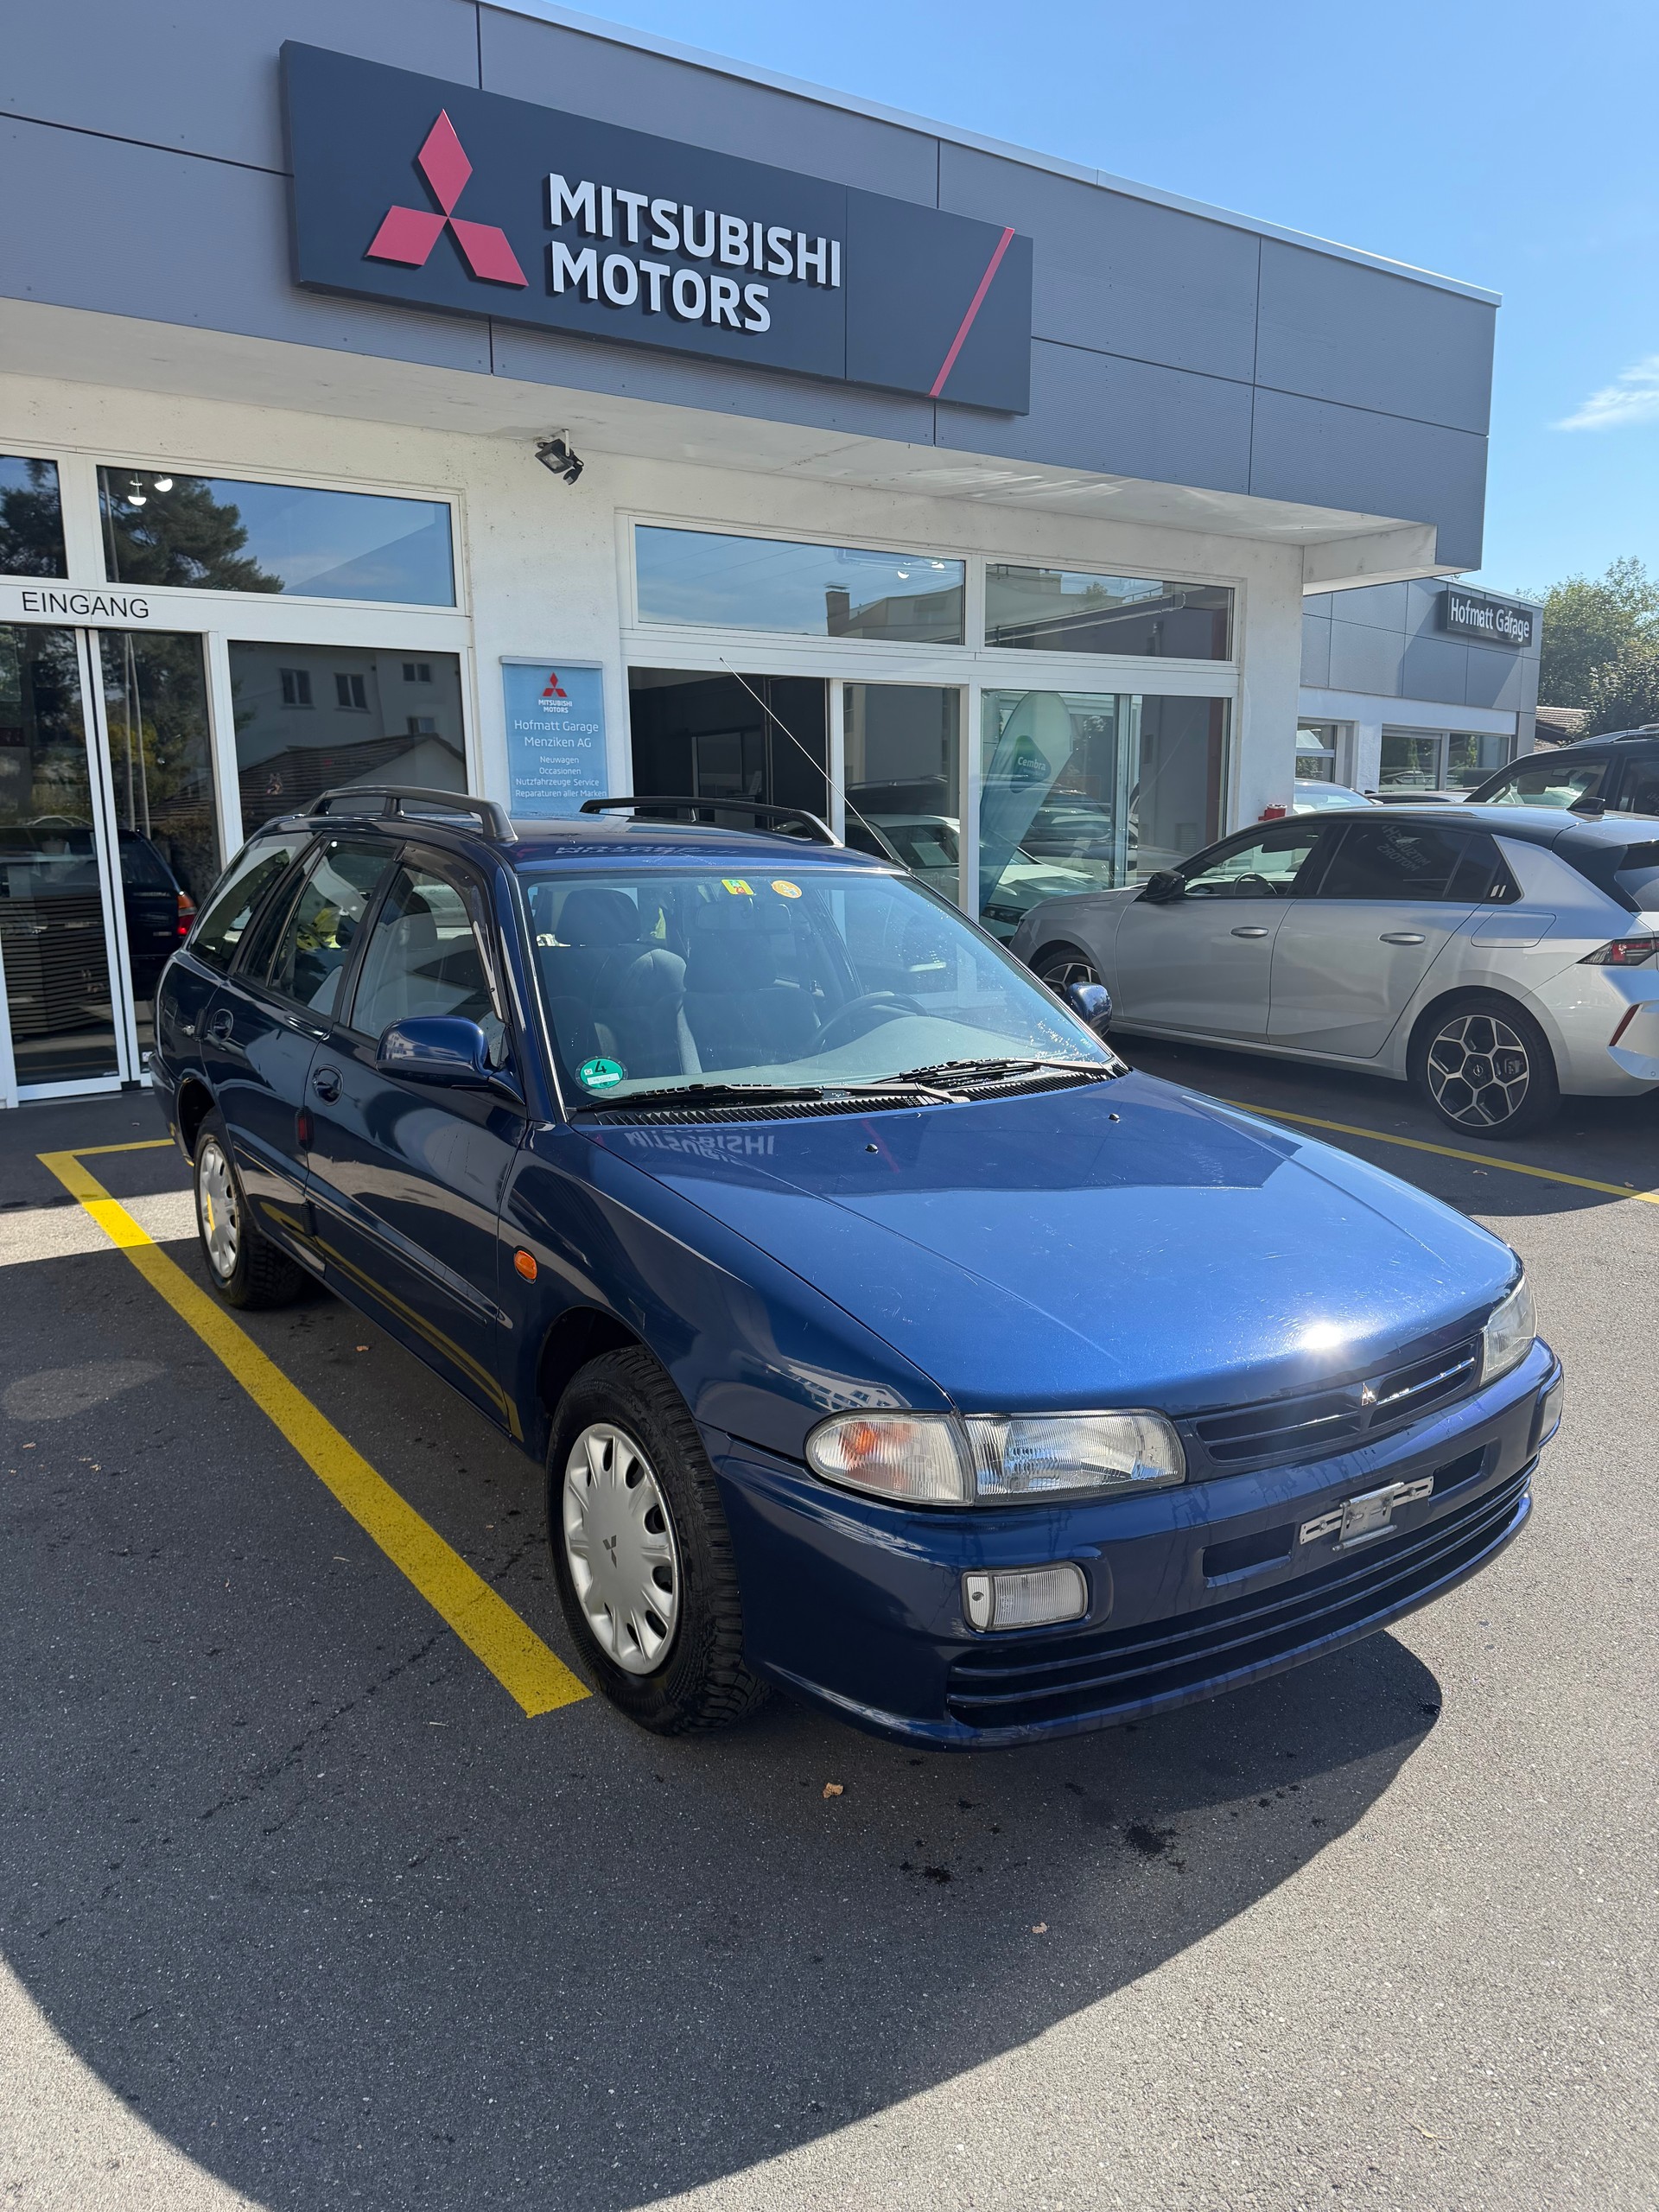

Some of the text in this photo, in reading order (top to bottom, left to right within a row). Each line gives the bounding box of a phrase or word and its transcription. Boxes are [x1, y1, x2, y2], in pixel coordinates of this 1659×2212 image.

[550, 173, 841, 288] MITSUBISHI
[551, 241, 772, 334] MOTORS
[22, 591, 149, 619] EINGANG
[1451, 597, 1530, 643] Hofmatt Garage
[514, 720, 598, 734] Hofmatt Garage
[524, 736, 591, 747] Menziken AG
[1018, 756, 1046, 771] Cembra
[516, 778, 571, 787] Nutzfahrzeuge
[516, 790, 562, 798] Reparaturen
[563, 789, 579, 798] aller
[594, 1060, 607, 1073] 4
